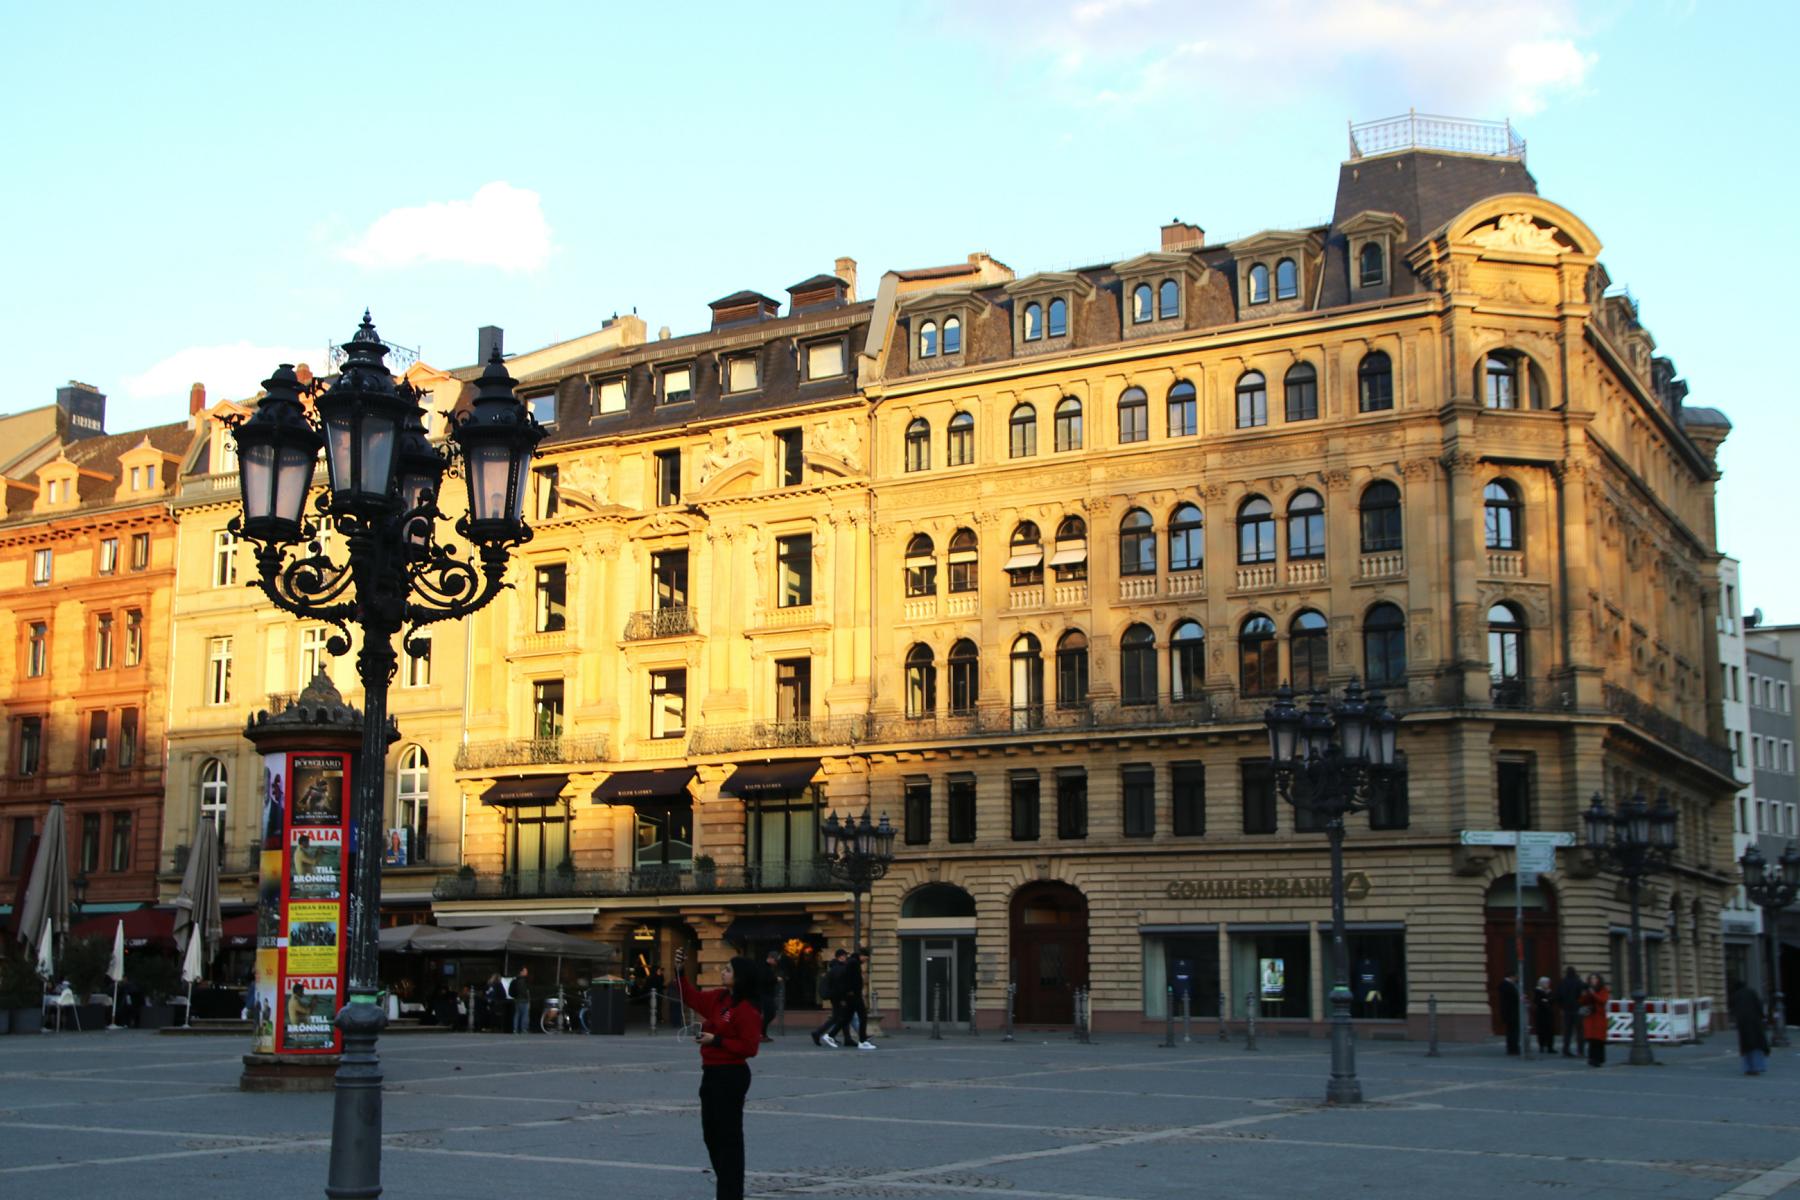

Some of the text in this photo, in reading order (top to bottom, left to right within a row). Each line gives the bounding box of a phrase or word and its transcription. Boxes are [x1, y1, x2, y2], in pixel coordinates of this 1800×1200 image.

[293, 830, 340, 841] ITALIA
[293, 874, 337, 882] BRÖNNER
[1166, 878, 1334, 900] COMMERZBANK
[287, 978, 335, 990] ITALIA
[310, 1015, 329, 1023] TILL
[287, 1023, 331, 1032] BRÖNNER
